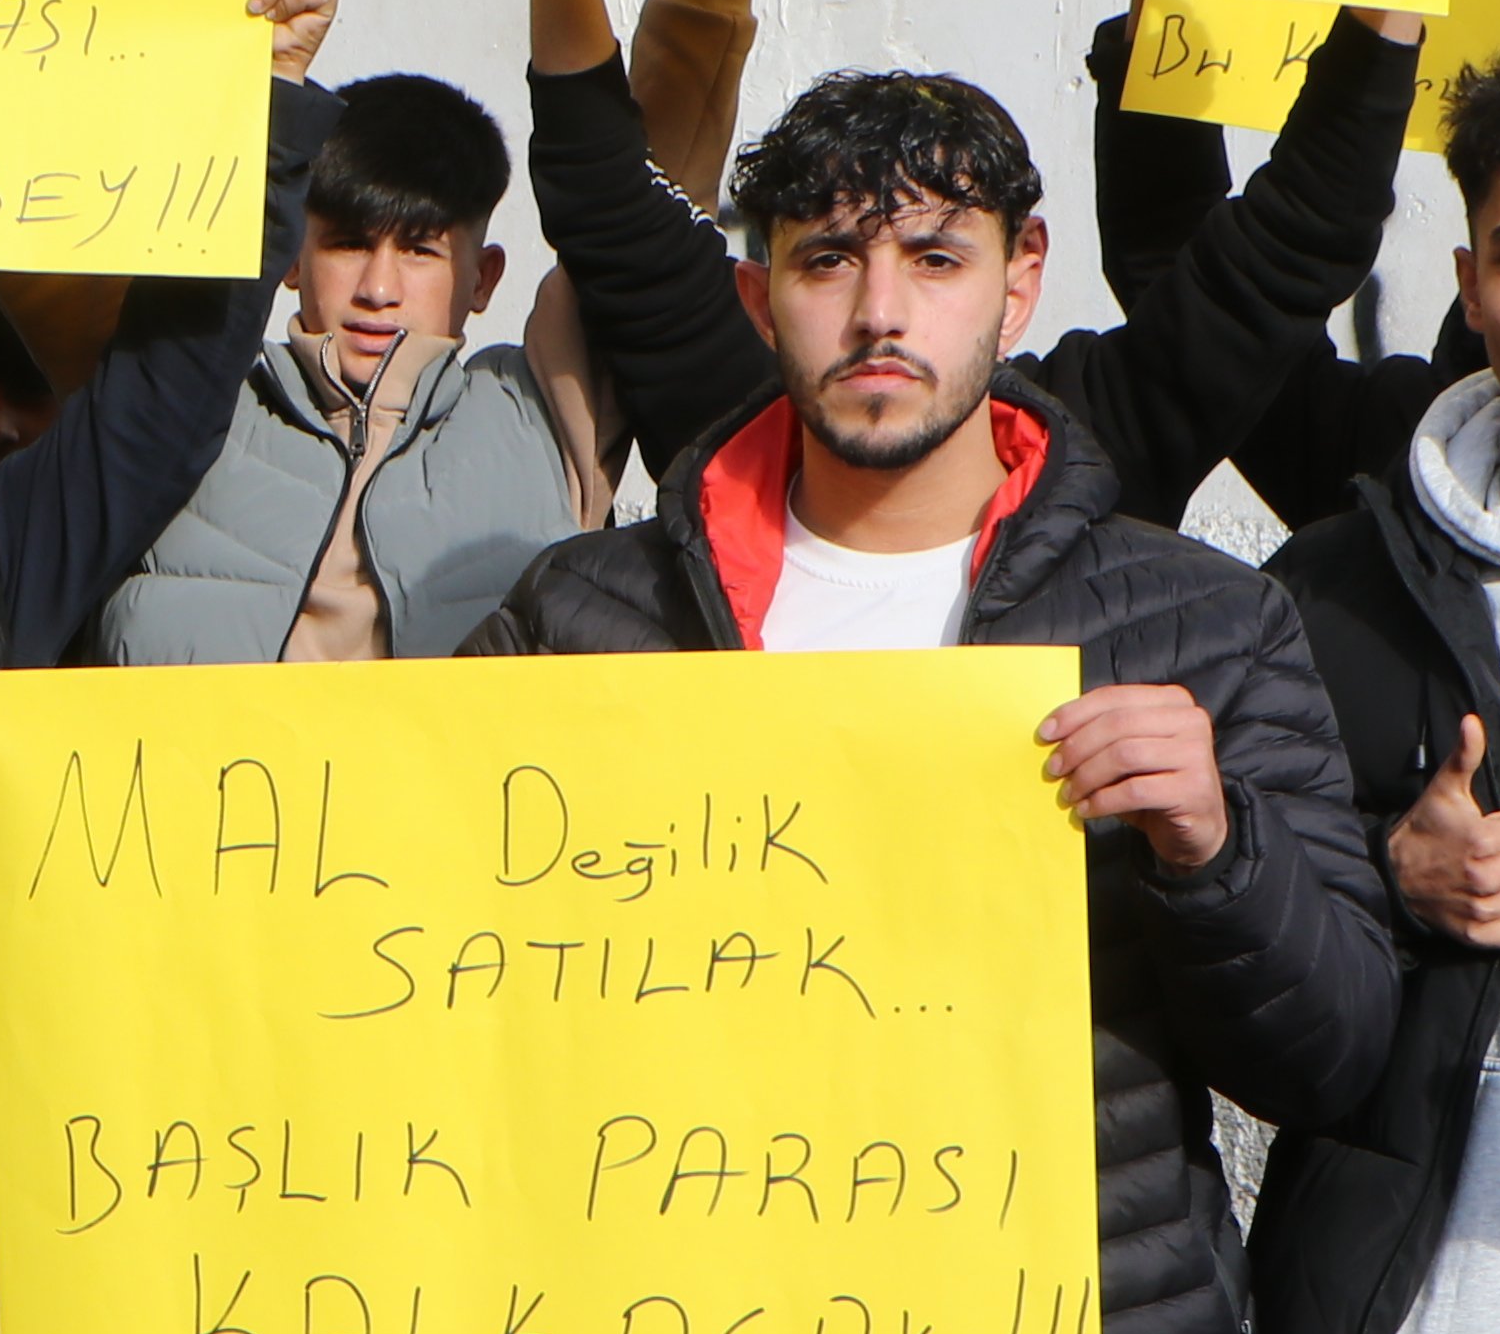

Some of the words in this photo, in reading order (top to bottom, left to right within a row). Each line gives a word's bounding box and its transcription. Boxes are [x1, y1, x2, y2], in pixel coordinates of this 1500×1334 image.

[27, 736, 391, 902] MAL
[316, 924, 955, 1021] SATILAK...
[55, 1113, 473, 1236] BAŞLIK
[585, 1113, 1019, 1231] PARASI
